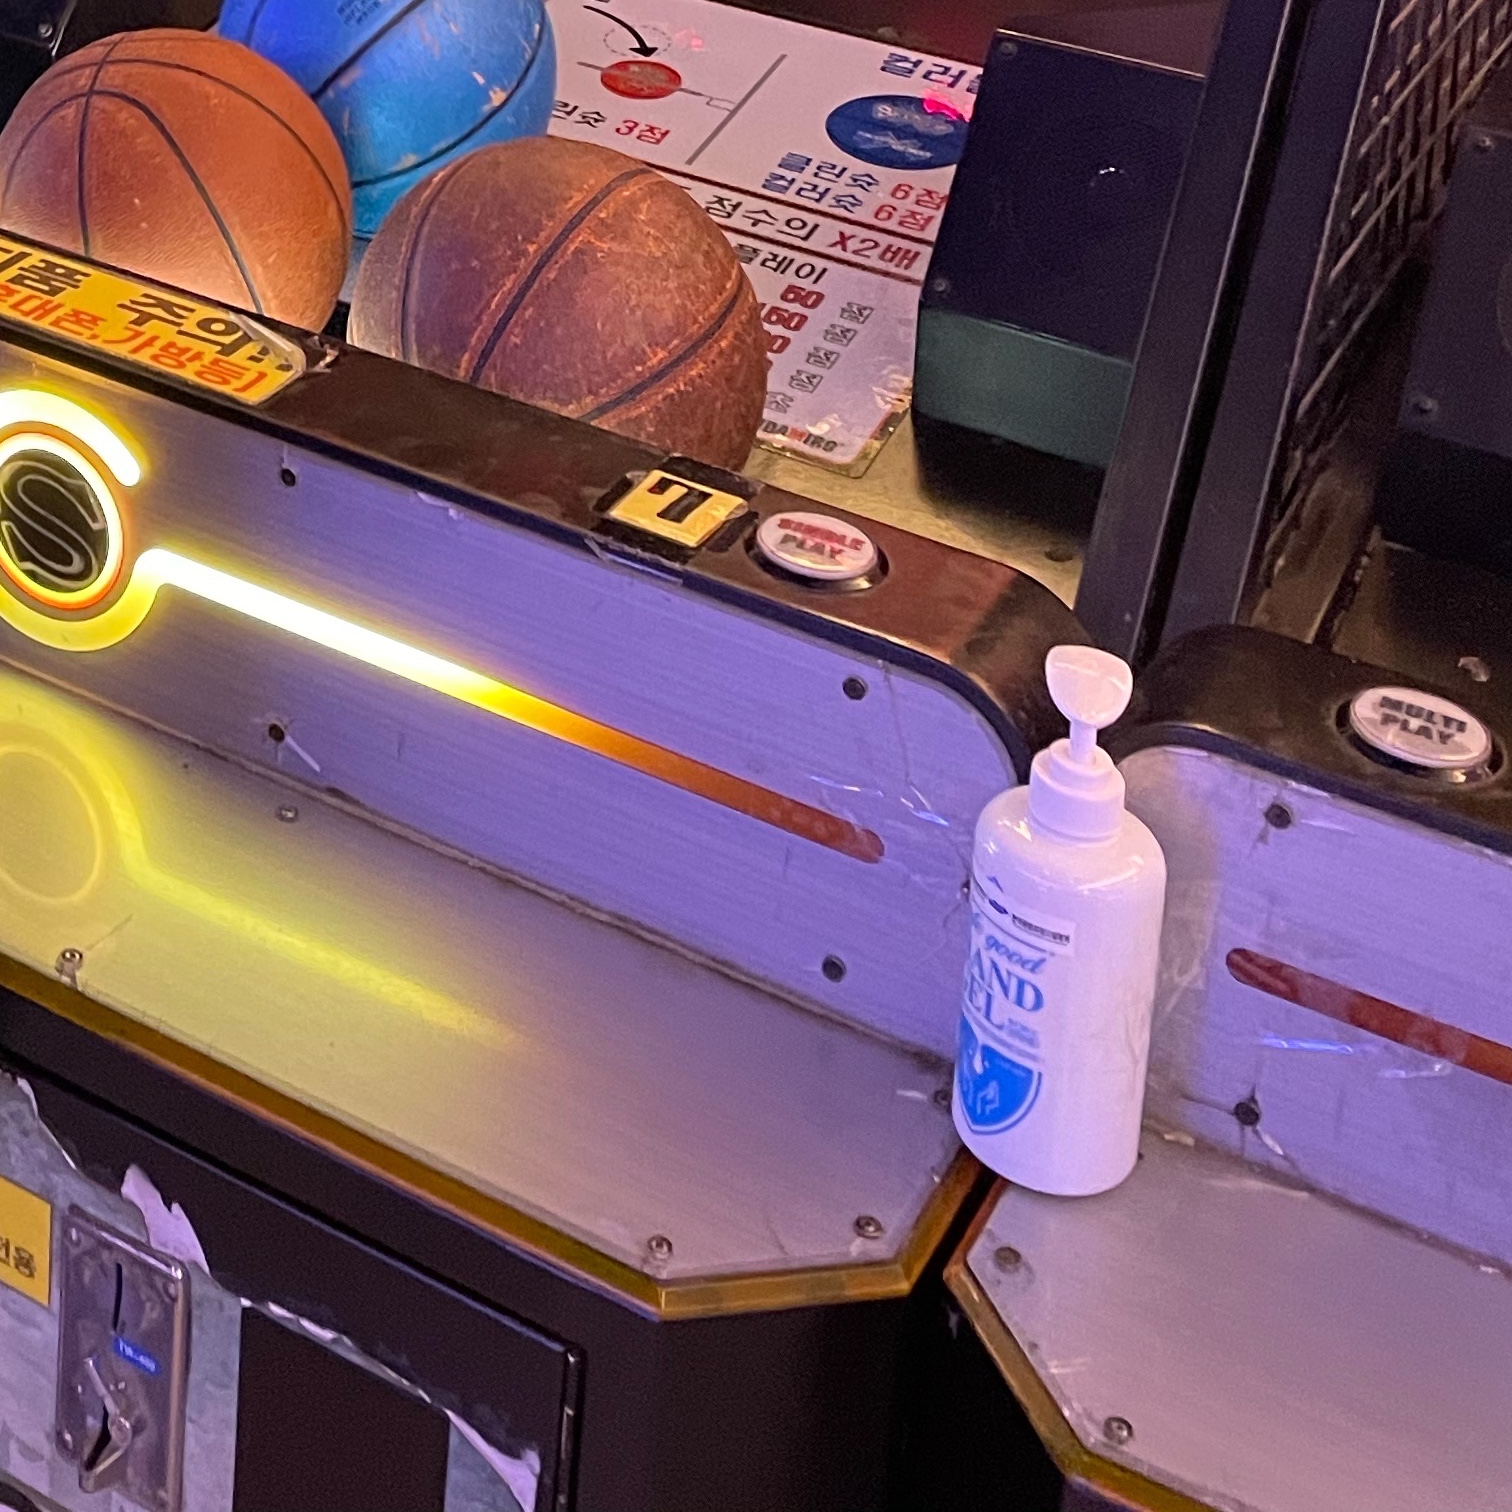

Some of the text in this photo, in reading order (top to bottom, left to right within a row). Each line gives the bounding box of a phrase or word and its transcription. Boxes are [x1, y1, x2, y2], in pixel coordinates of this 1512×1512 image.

[615, 119, 671, 145] 3점
[890, 182, 949, 211] 6점
[874, 204, 934, 232] 6점
[756, 302, 808, 332] 60
[1379, 696, 1467, 733] MULTI
[1380, 713, 1455, 745] PLAY
[985, 934, 1047, 974] good
[968, 947, 1044, 1013] AND
